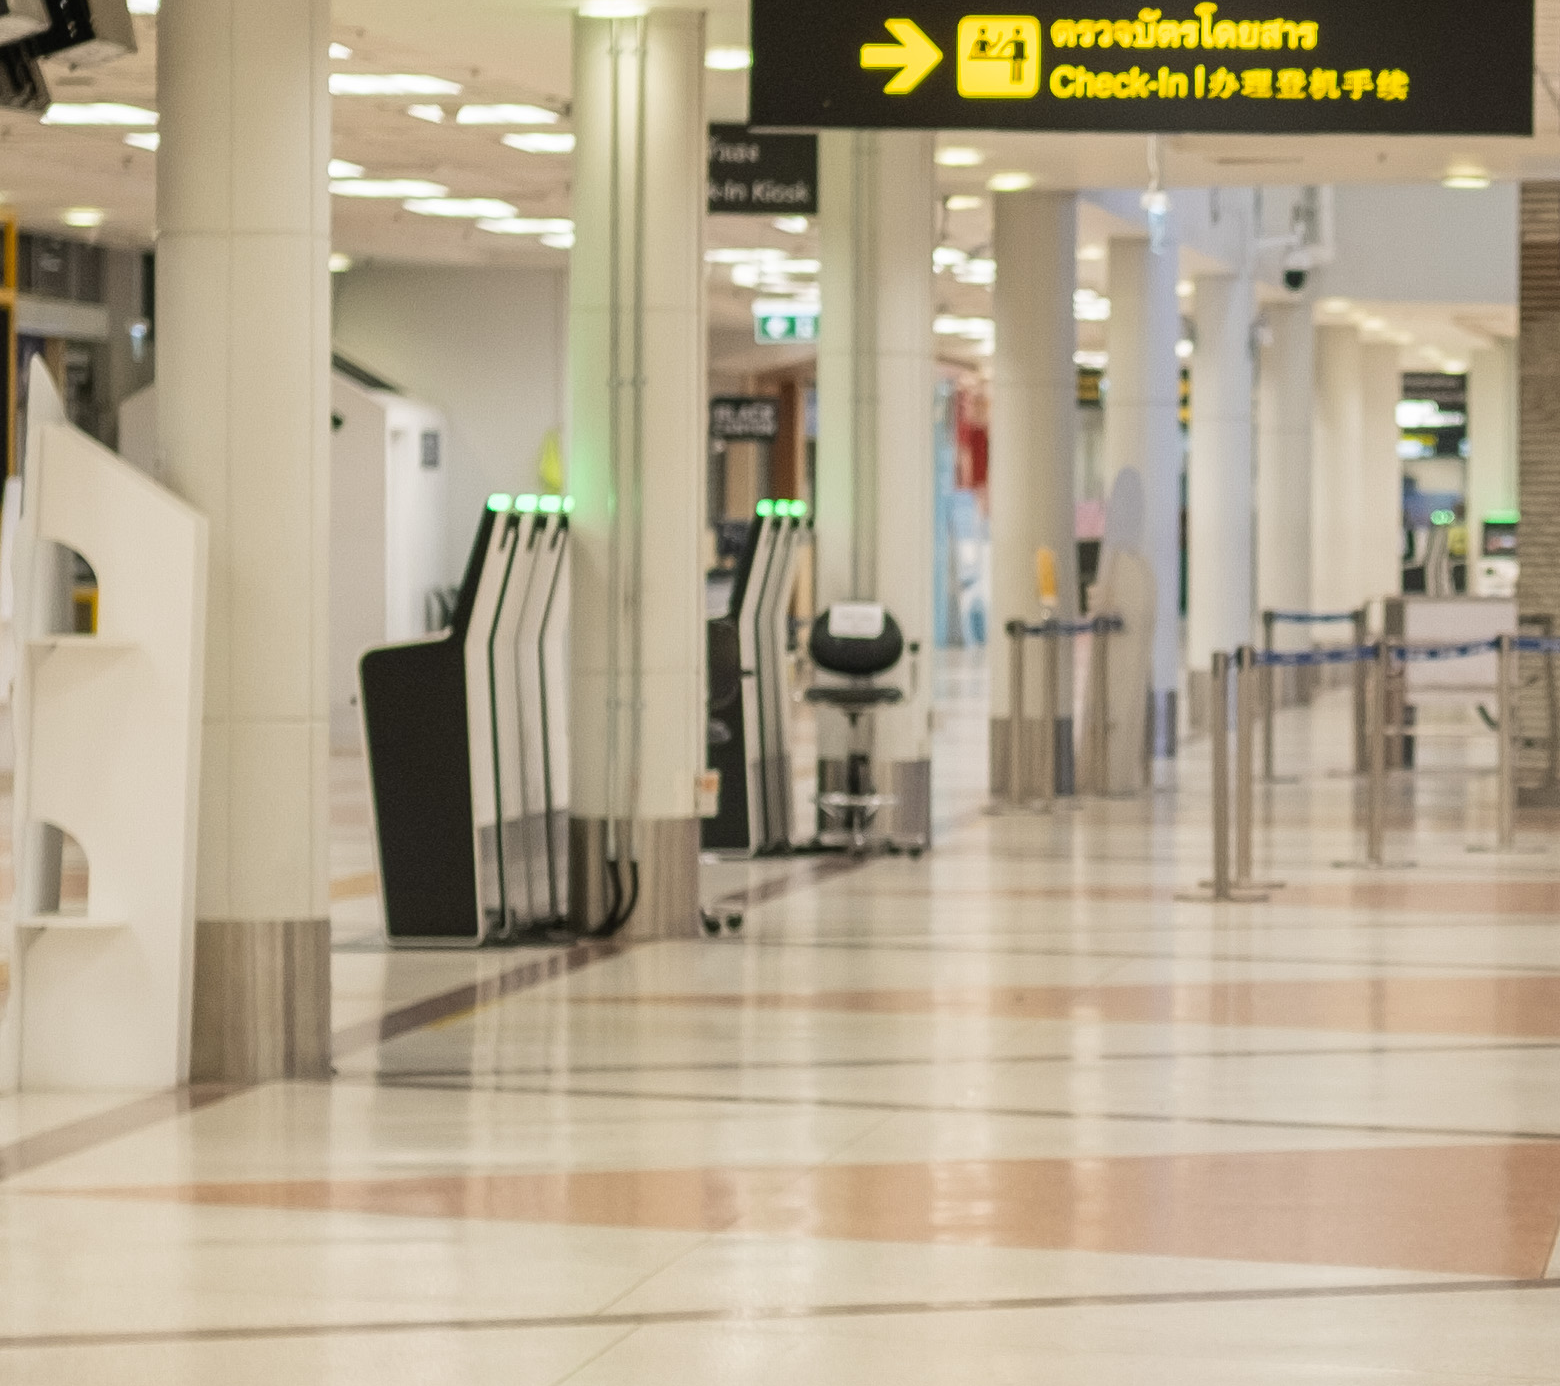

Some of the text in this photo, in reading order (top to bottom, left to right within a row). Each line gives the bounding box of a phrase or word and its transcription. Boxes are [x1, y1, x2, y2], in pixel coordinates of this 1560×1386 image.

[1050, 1, 1319, 50] ตรวจบัตรโดยสาร
